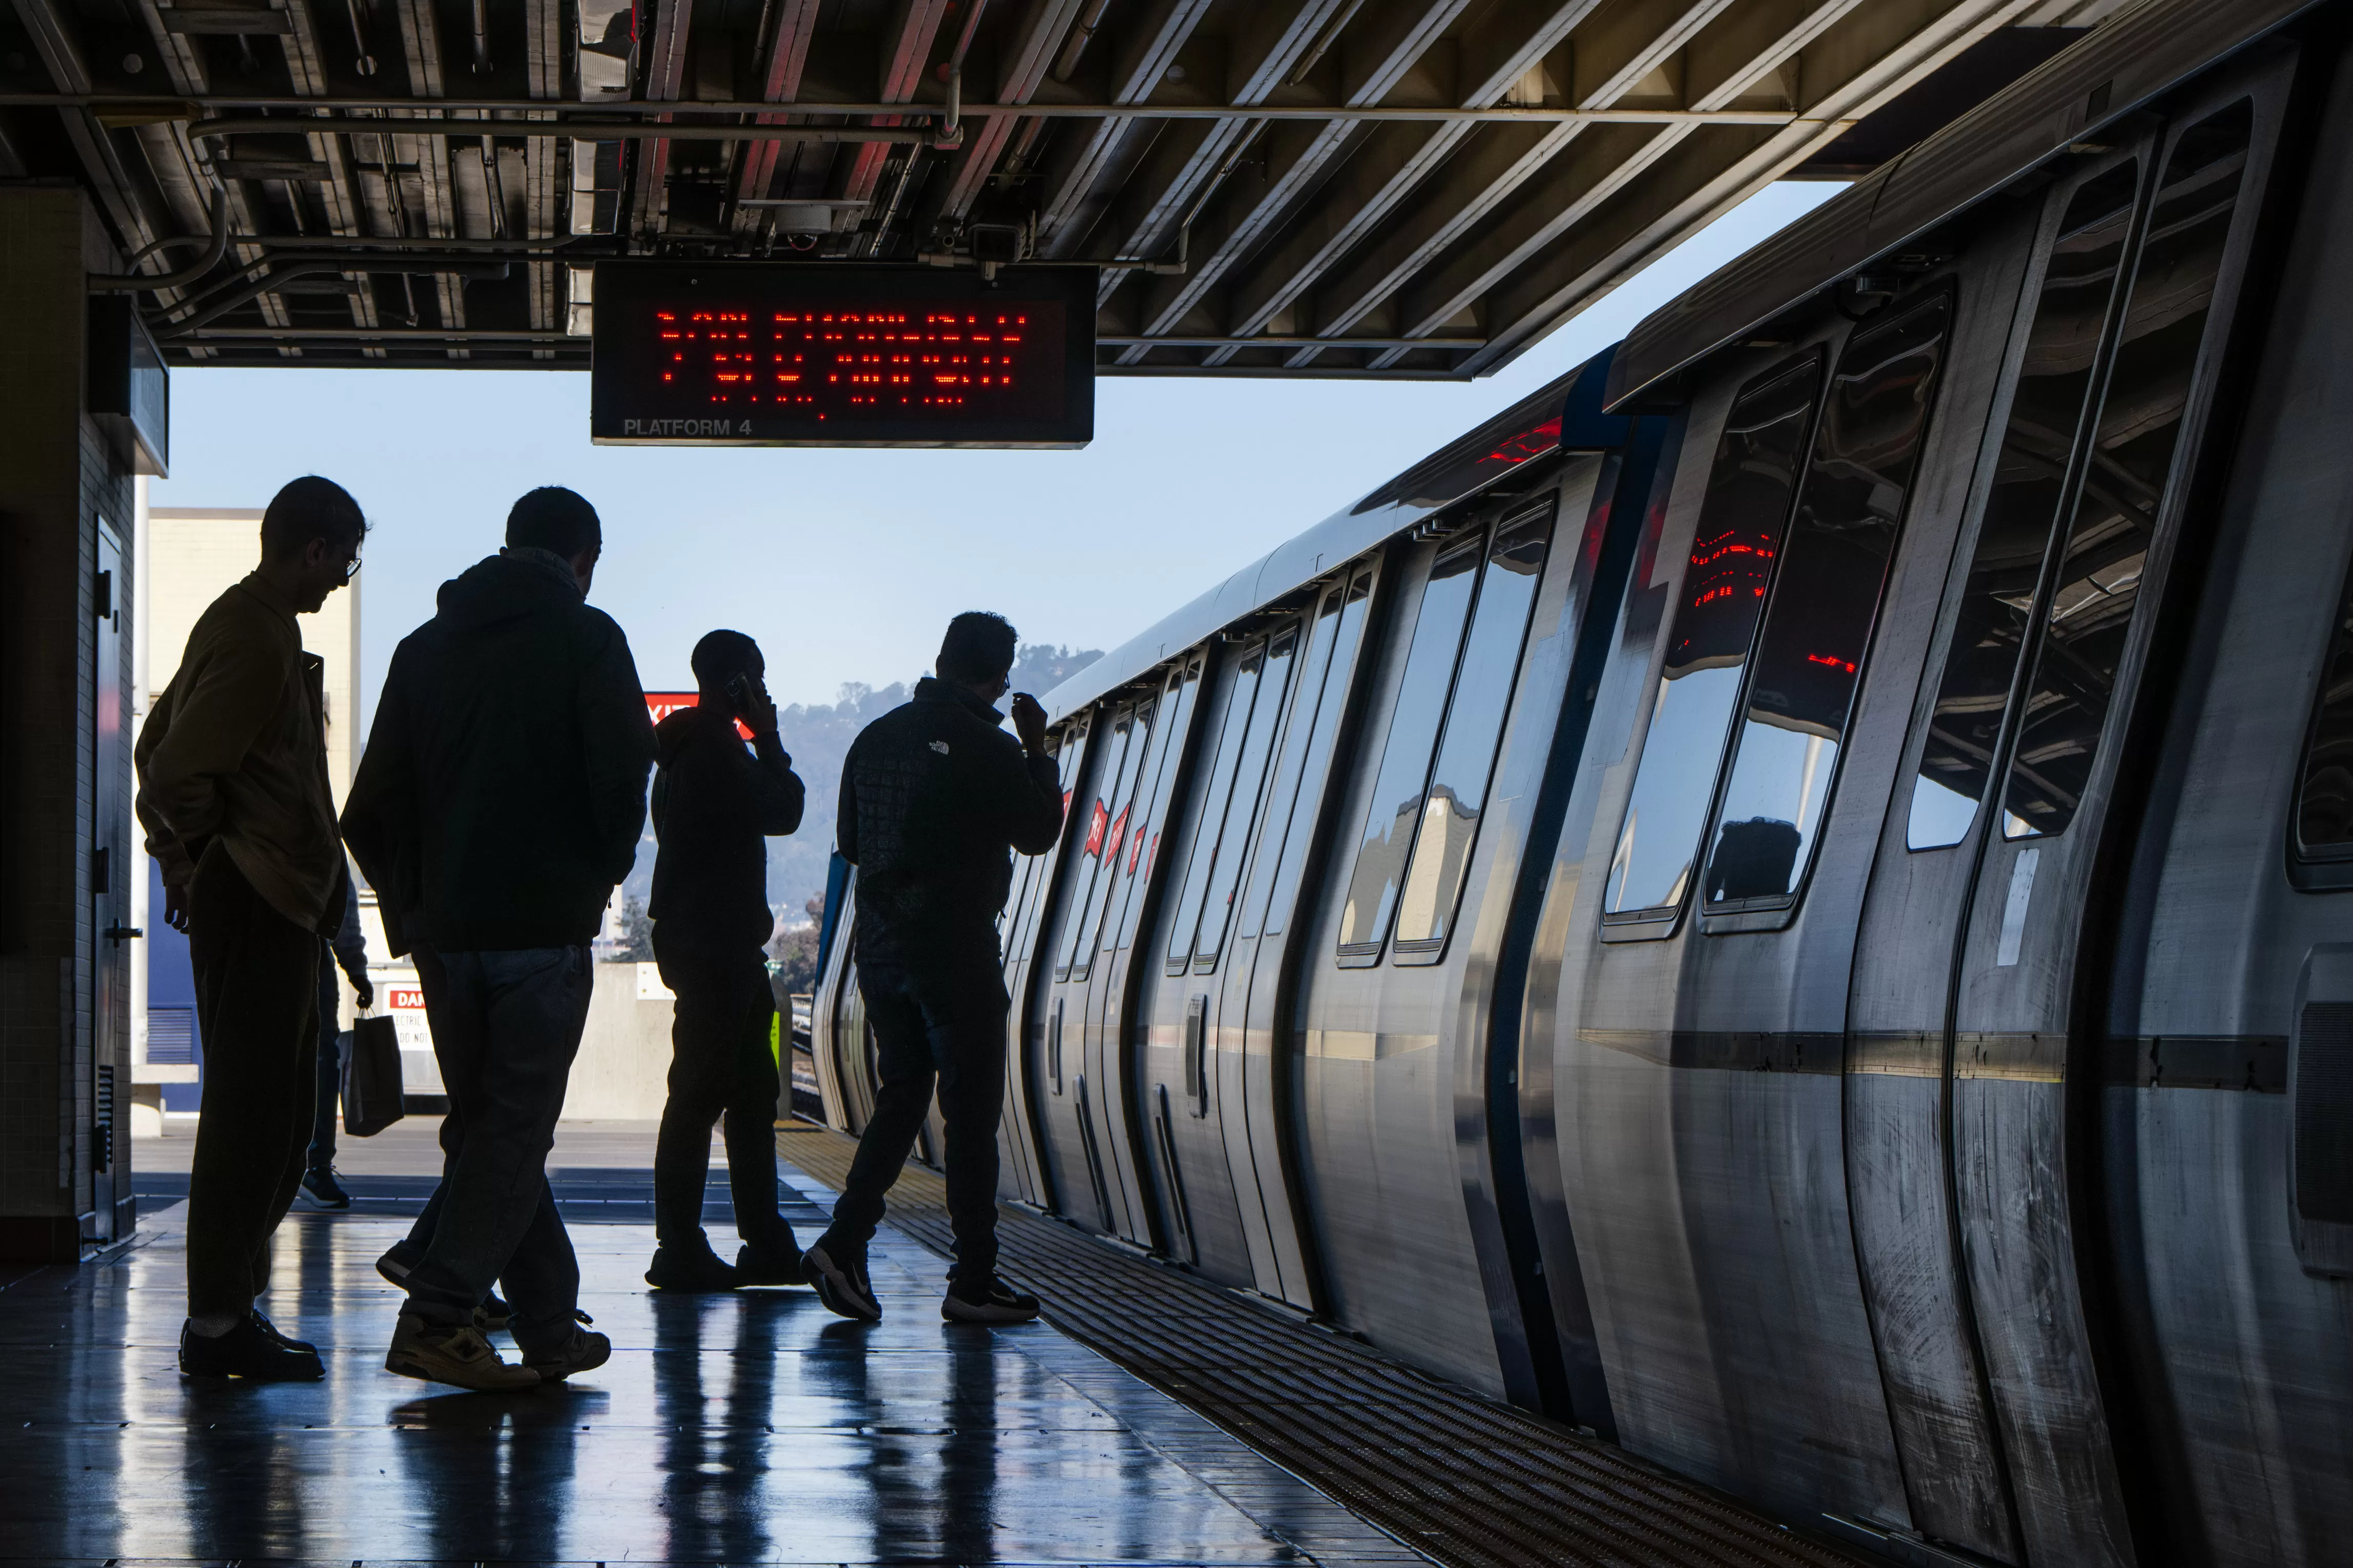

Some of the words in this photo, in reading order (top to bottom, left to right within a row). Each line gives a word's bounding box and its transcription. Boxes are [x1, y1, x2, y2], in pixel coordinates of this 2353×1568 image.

[624, 419, 730, 435] PLATFORM
[739, 419, 752, 435] 4
[398, 993, 425, 1006] DAN
[396, 1016, 421, 1026] ECTRIC
[400, 1033, 409, 1043] DO
